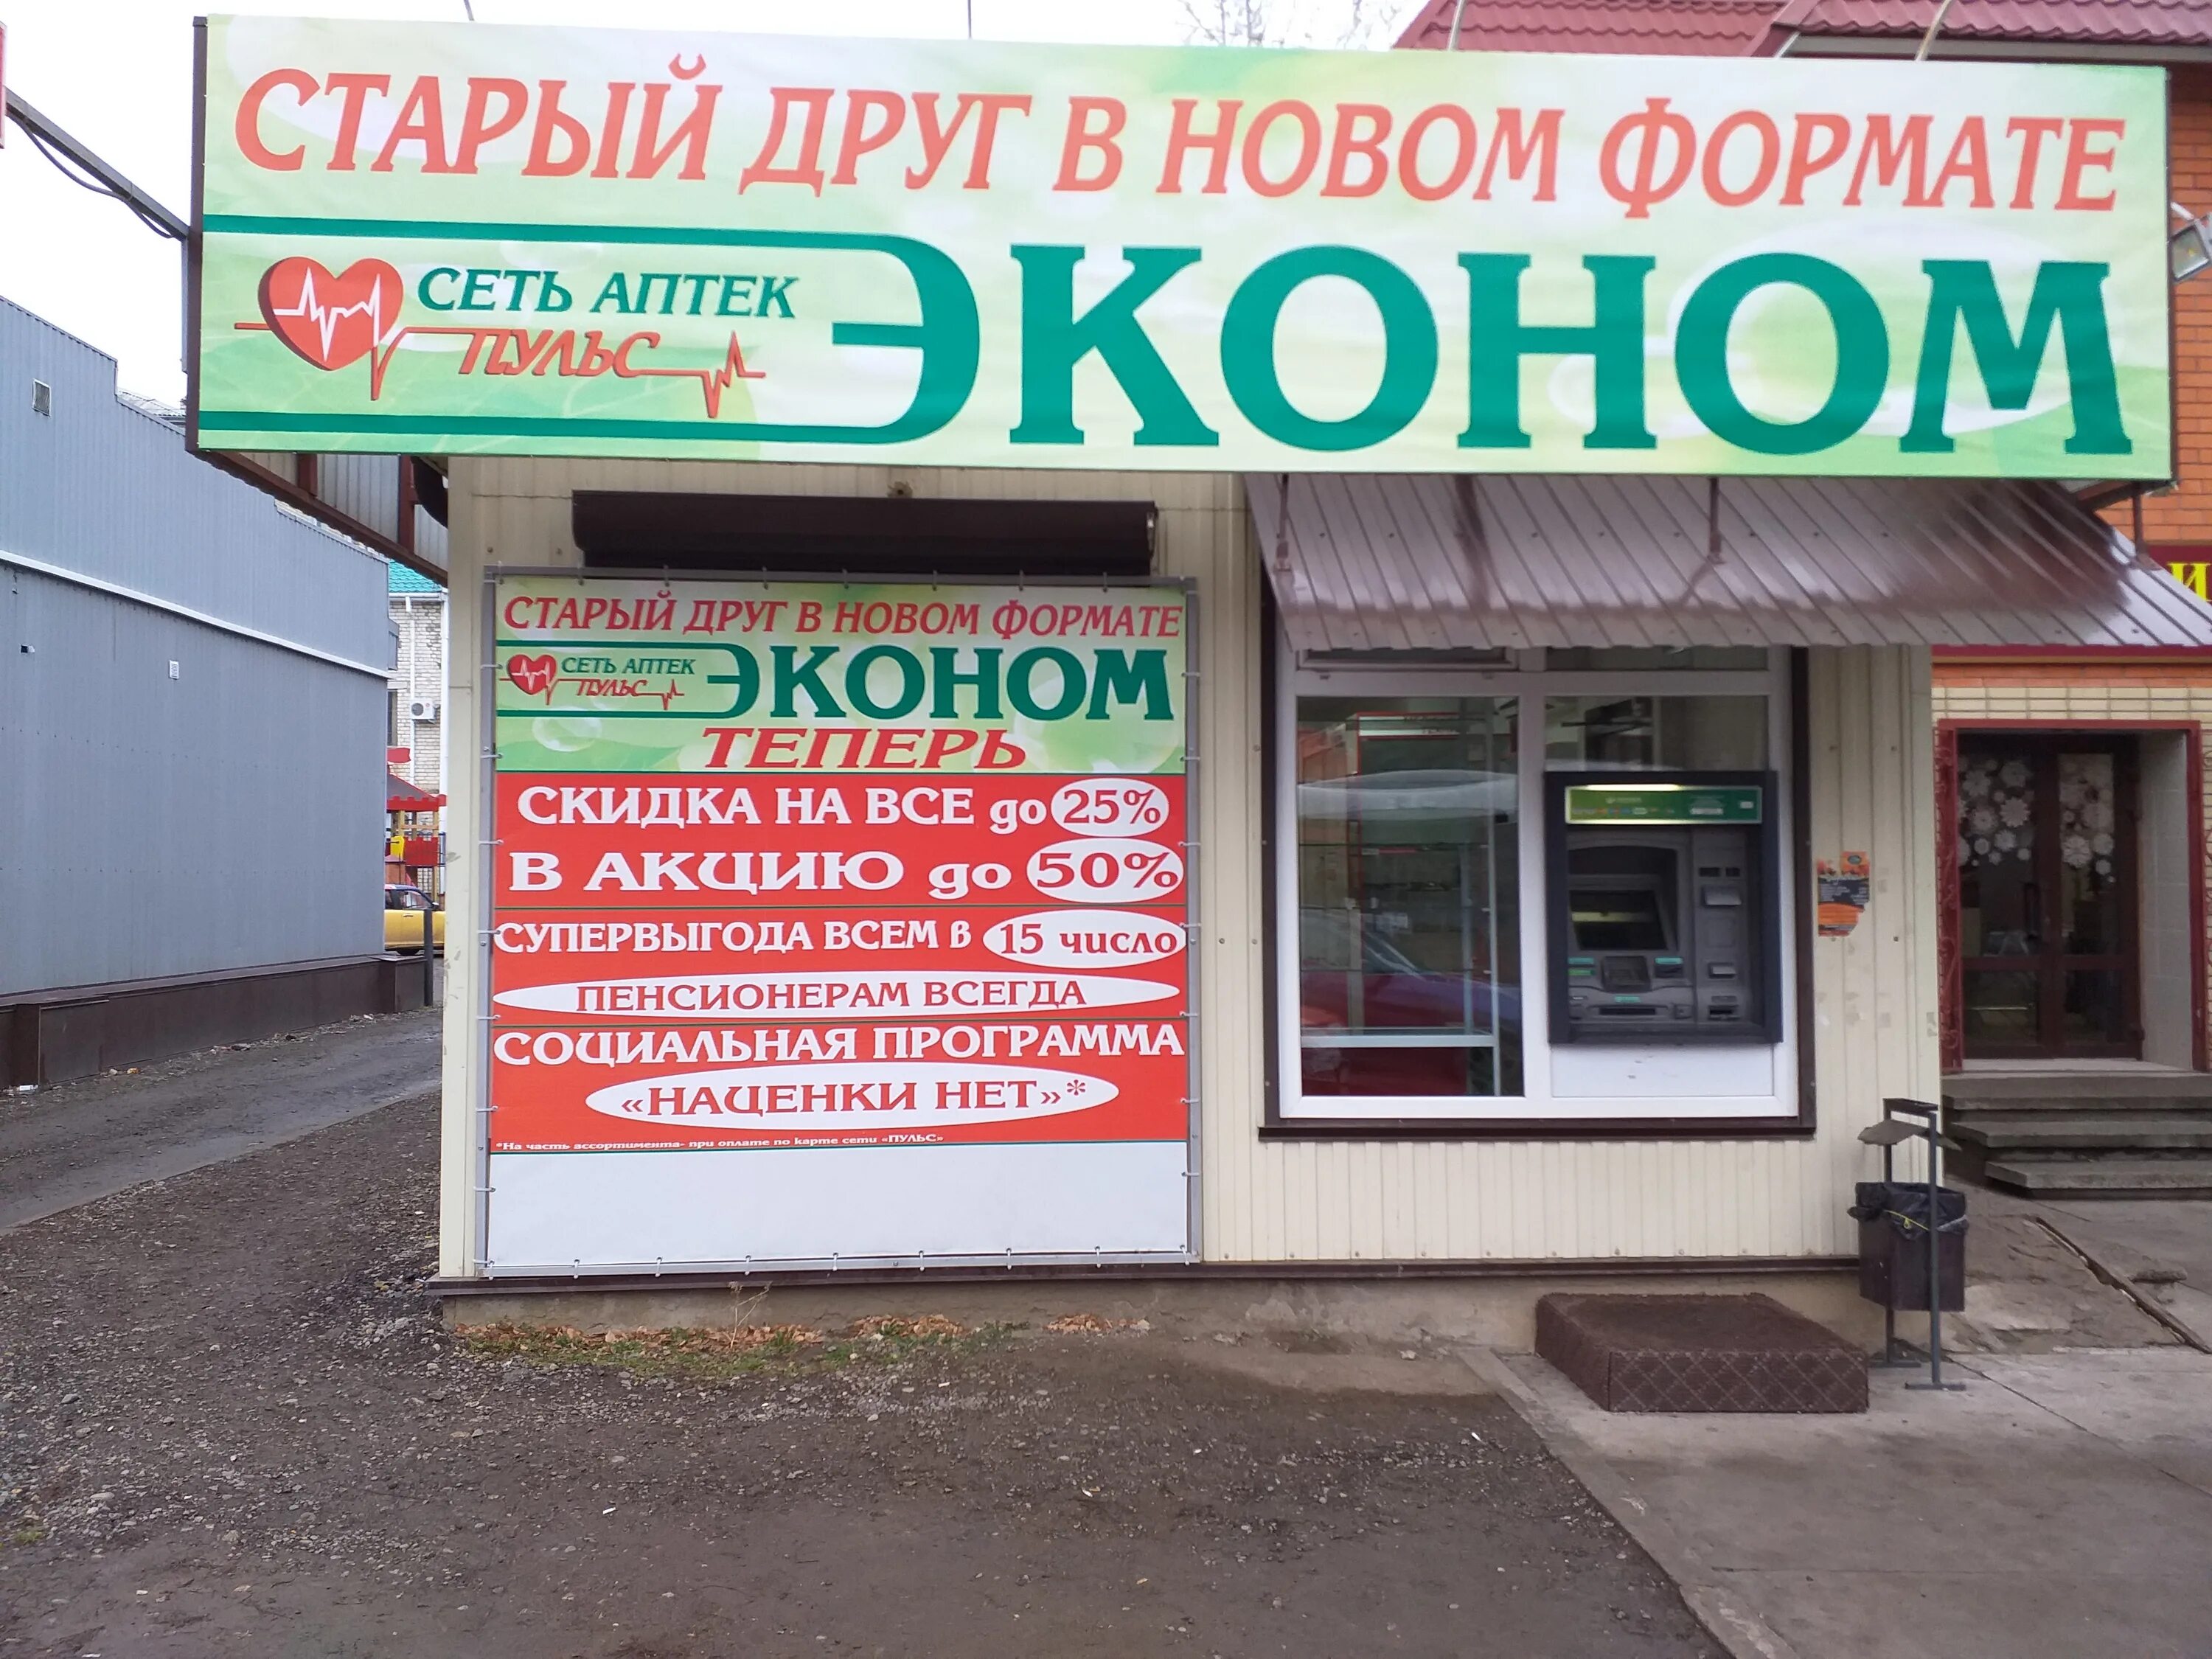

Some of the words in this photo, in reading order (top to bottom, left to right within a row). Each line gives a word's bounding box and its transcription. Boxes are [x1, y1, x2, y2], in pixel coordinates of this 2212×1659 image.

[235, 53, 722, 180] СТАРЫЙ
[739, 86, 1033, 197] ДРУГ
[1053, 96, 1127, 192] В
[1155, 98, 1565, 202] НОВОМ
[1599, 97, 2126, 219] ФОРМАТЕ
[417, 266, 573, 316] СЕТЬ
[589, 271, 799, 319] АПТЕК
[457, 326, 661, 378] ПУЛЬС
[832, 234, 2133, 457] ЭКОНОМ
[504, 591, 677, 630] СТАРЫЙ
[683, 599, 788, 636] ДРУГ
[793, 603, 821, 633] В
[832, 602, 980, 636] НОВОМ
[992, 599, 1182, 639] ФОРМАТЕ
[562, 657, 616, 674] СЕТЬ
[622, 658, 695, 675] АПТЕК
[576, 678, 647, 697] ПУЛЬС
[707, 644, 1175, 720] ЭКОНОМ
[702, 728, 1026, 769] ТЕПЕРЬ
[517, 786, 761, 829] СКИДКА
[775, 787, 851, 825] НА
[865, 787, 975, 825] ВСЕ
[990, 799, 1047, 835] до
[1063, 789, 1161, 824] 25%
[509, 852, 563, 891] В
[582, 851, 904, 894] АКЦИЮ
[928, 863, 1012, 900] до
[1037, 852, 1178, 888] 50%
[495, 921, 814, 955] СУПЕРВЫГОДА
[823, 919, 938, 951] ВСЕМ
[1001, 923, 1043, 954] 15
[1060, 932, 1178, 954] число
[576, 981, 911, 1012] ПЕНСИОНЕРАМ
[924, 979, 1086, 1009] ВСЕГДА
[493, 1026, 857, 1068] СОЦИАЛЬНАЯ
[873, 1023, 1185, 1060] ПРОГРАММА
[622, 1081, 916, 1116] «НАЦЕНКИ
[689, 1140, 714, 1149] при
[717, 1138, 771, 1147] оплате
[794, 1136, 838, 1147] карте
[882, 1133, 944, 1143] «ПУЛЬС»
